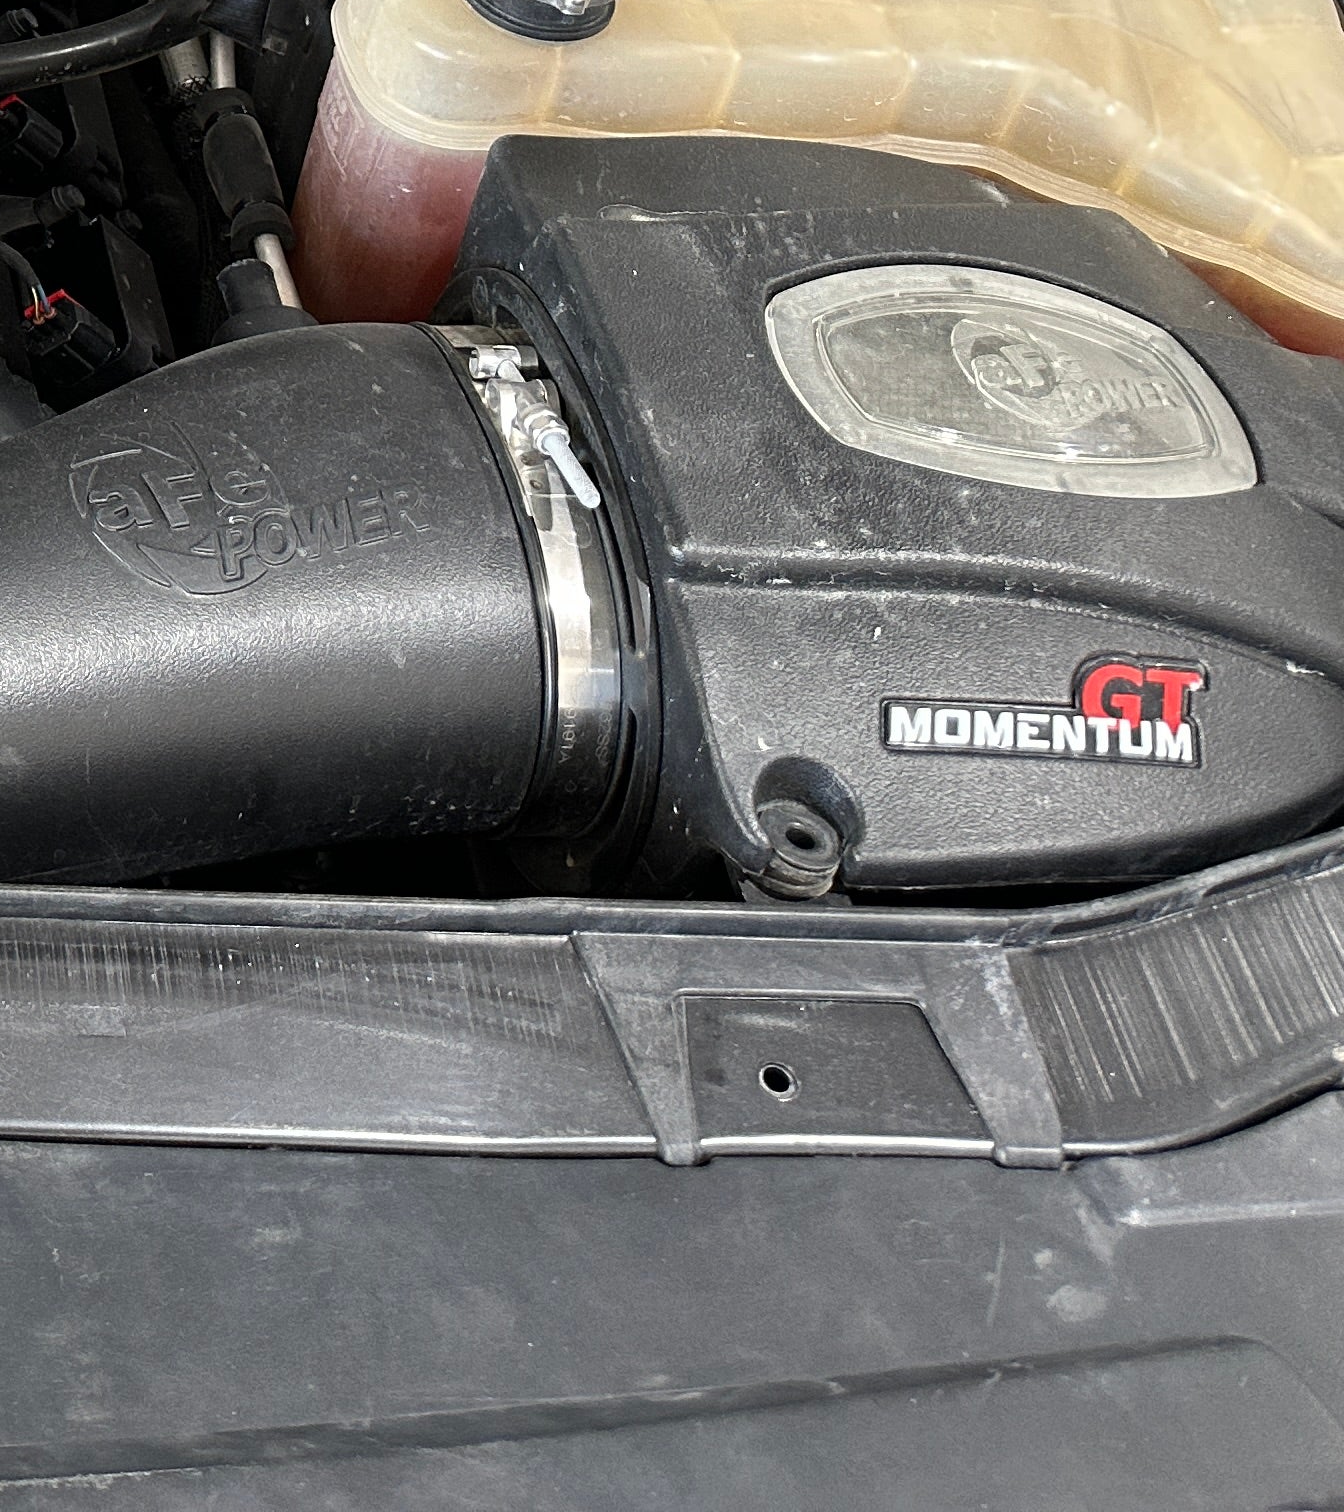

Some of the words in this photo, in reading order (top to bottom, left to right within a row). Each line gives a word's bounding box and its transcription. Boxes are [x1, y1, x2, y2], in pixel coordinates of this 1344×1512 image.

[1058, 377, 1178, 418] POWER
[214, 488, 431, 583] POWER
[1081, 662, 1205, 731] GT
[888, 705, 1194, 763] MOMENTUM
